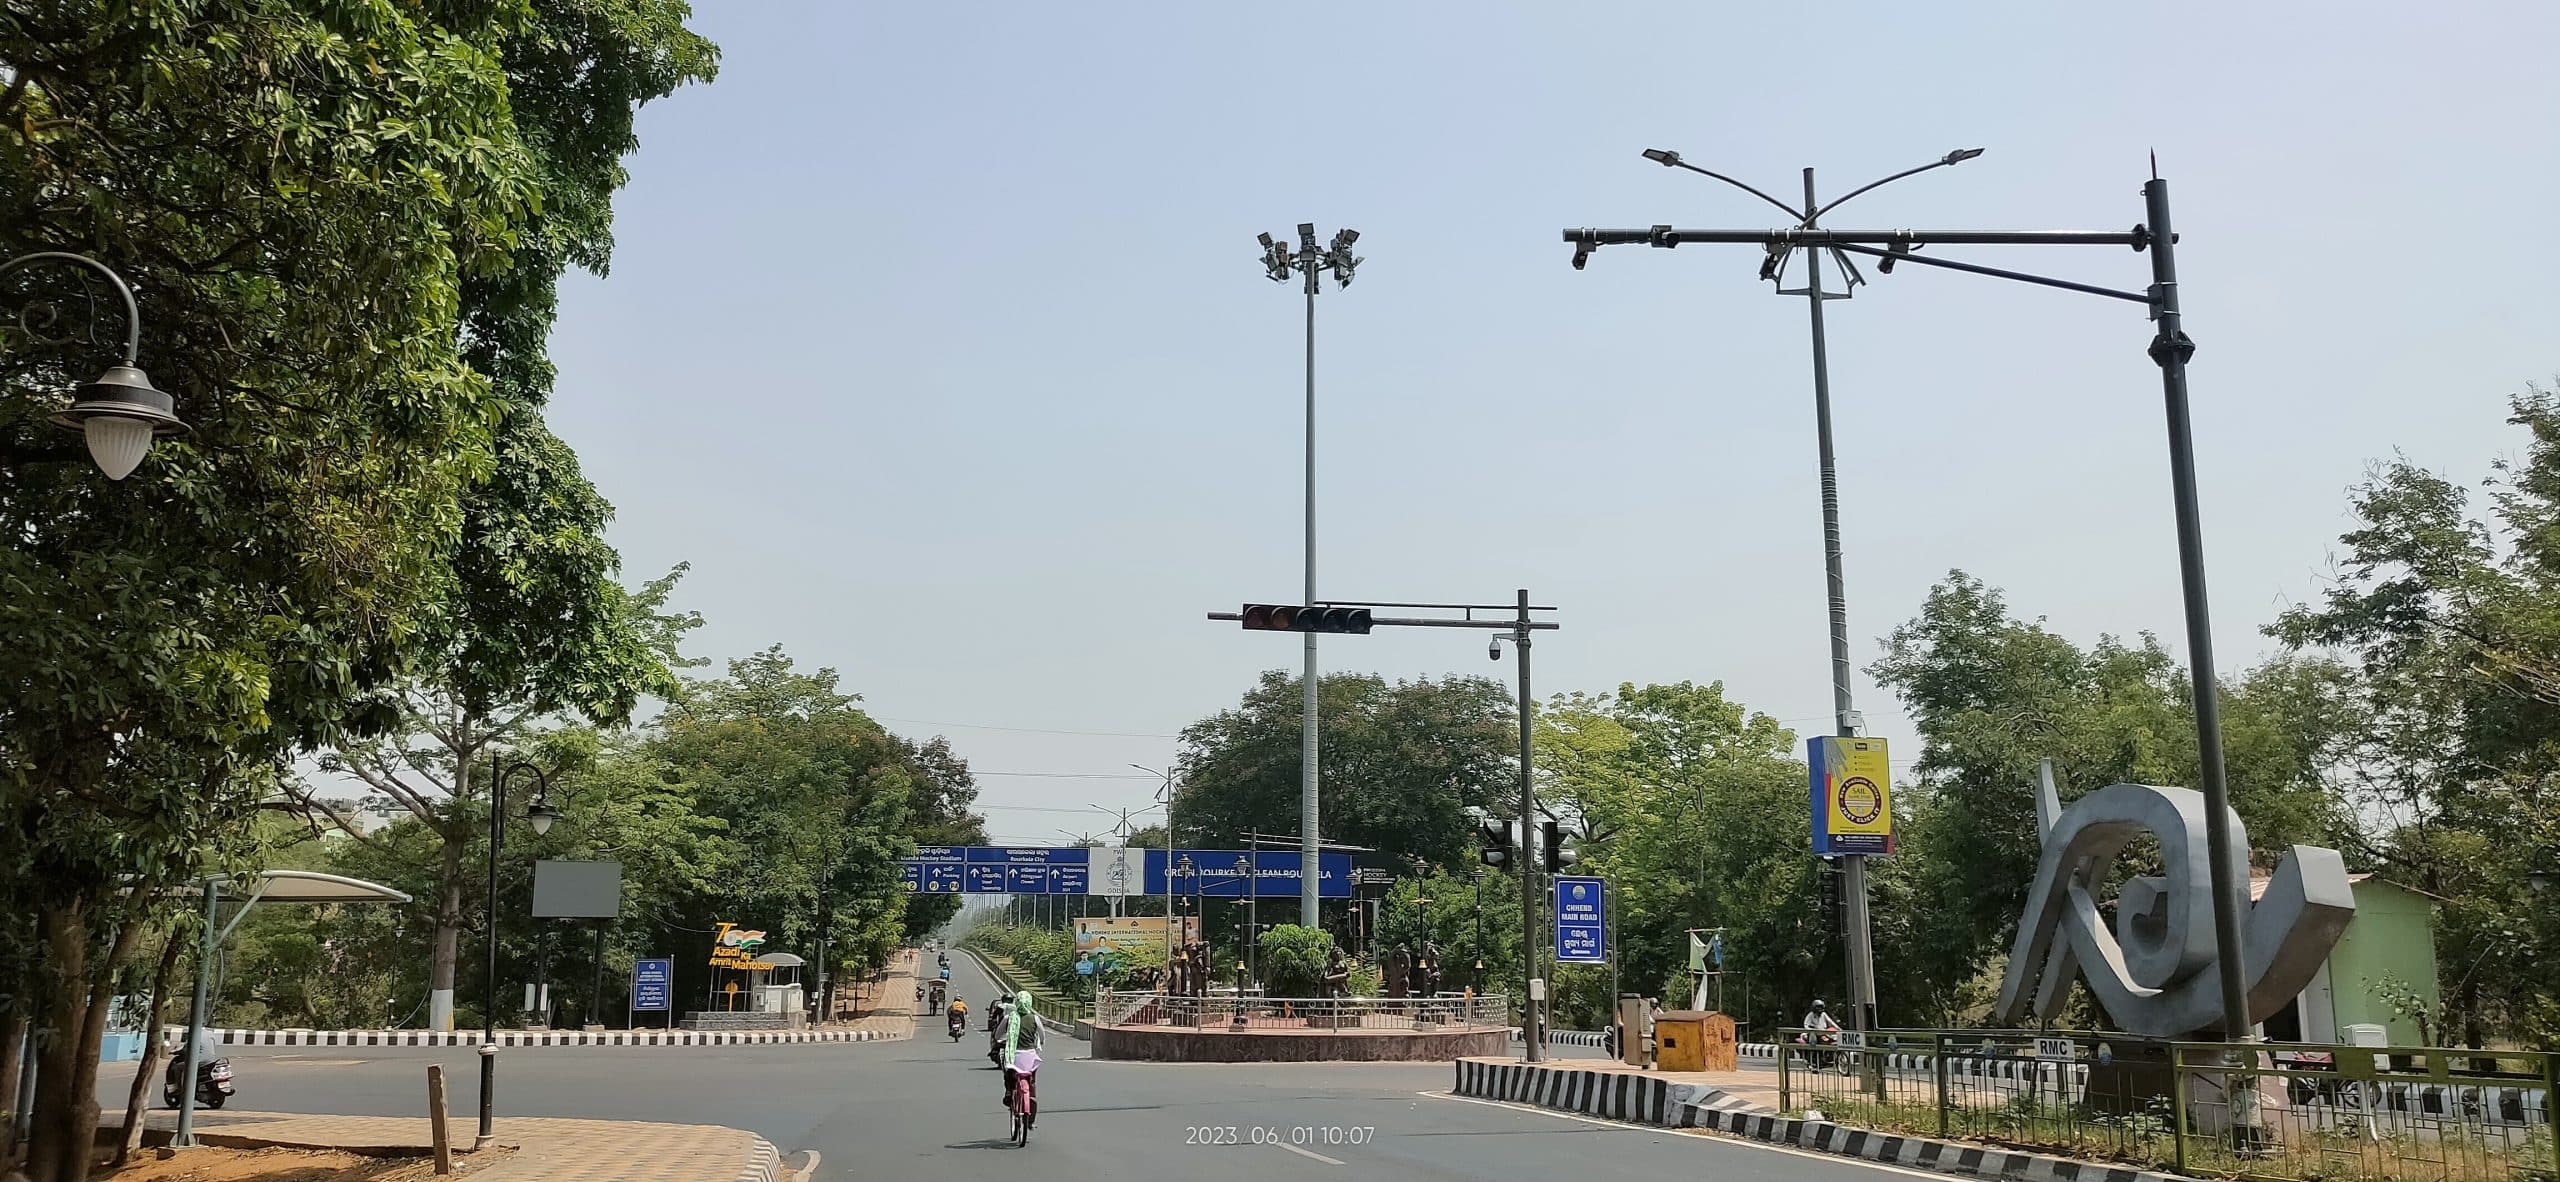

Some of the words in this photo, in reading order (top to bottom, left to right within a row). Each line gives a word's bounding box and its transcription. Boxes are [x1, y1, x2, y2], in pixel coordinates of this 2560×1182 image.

[1841, 807, 1856, 820] JUST
[1856, 814, 1875, 823] CLICK
[1561, 913, 1579, 921] MAIN
[1579, 913, 1598, 921] ROAD
[712, 946, 741, 956] Azadi
[740, 952, 751, 960] Ka
[709, 957, 732, 966] Amrit
[731, 960, 776, 970] Mahotsav
[1841, 1033, 1860, 1045] RMC
[2040, 1040, 2067, 1055] RMC
